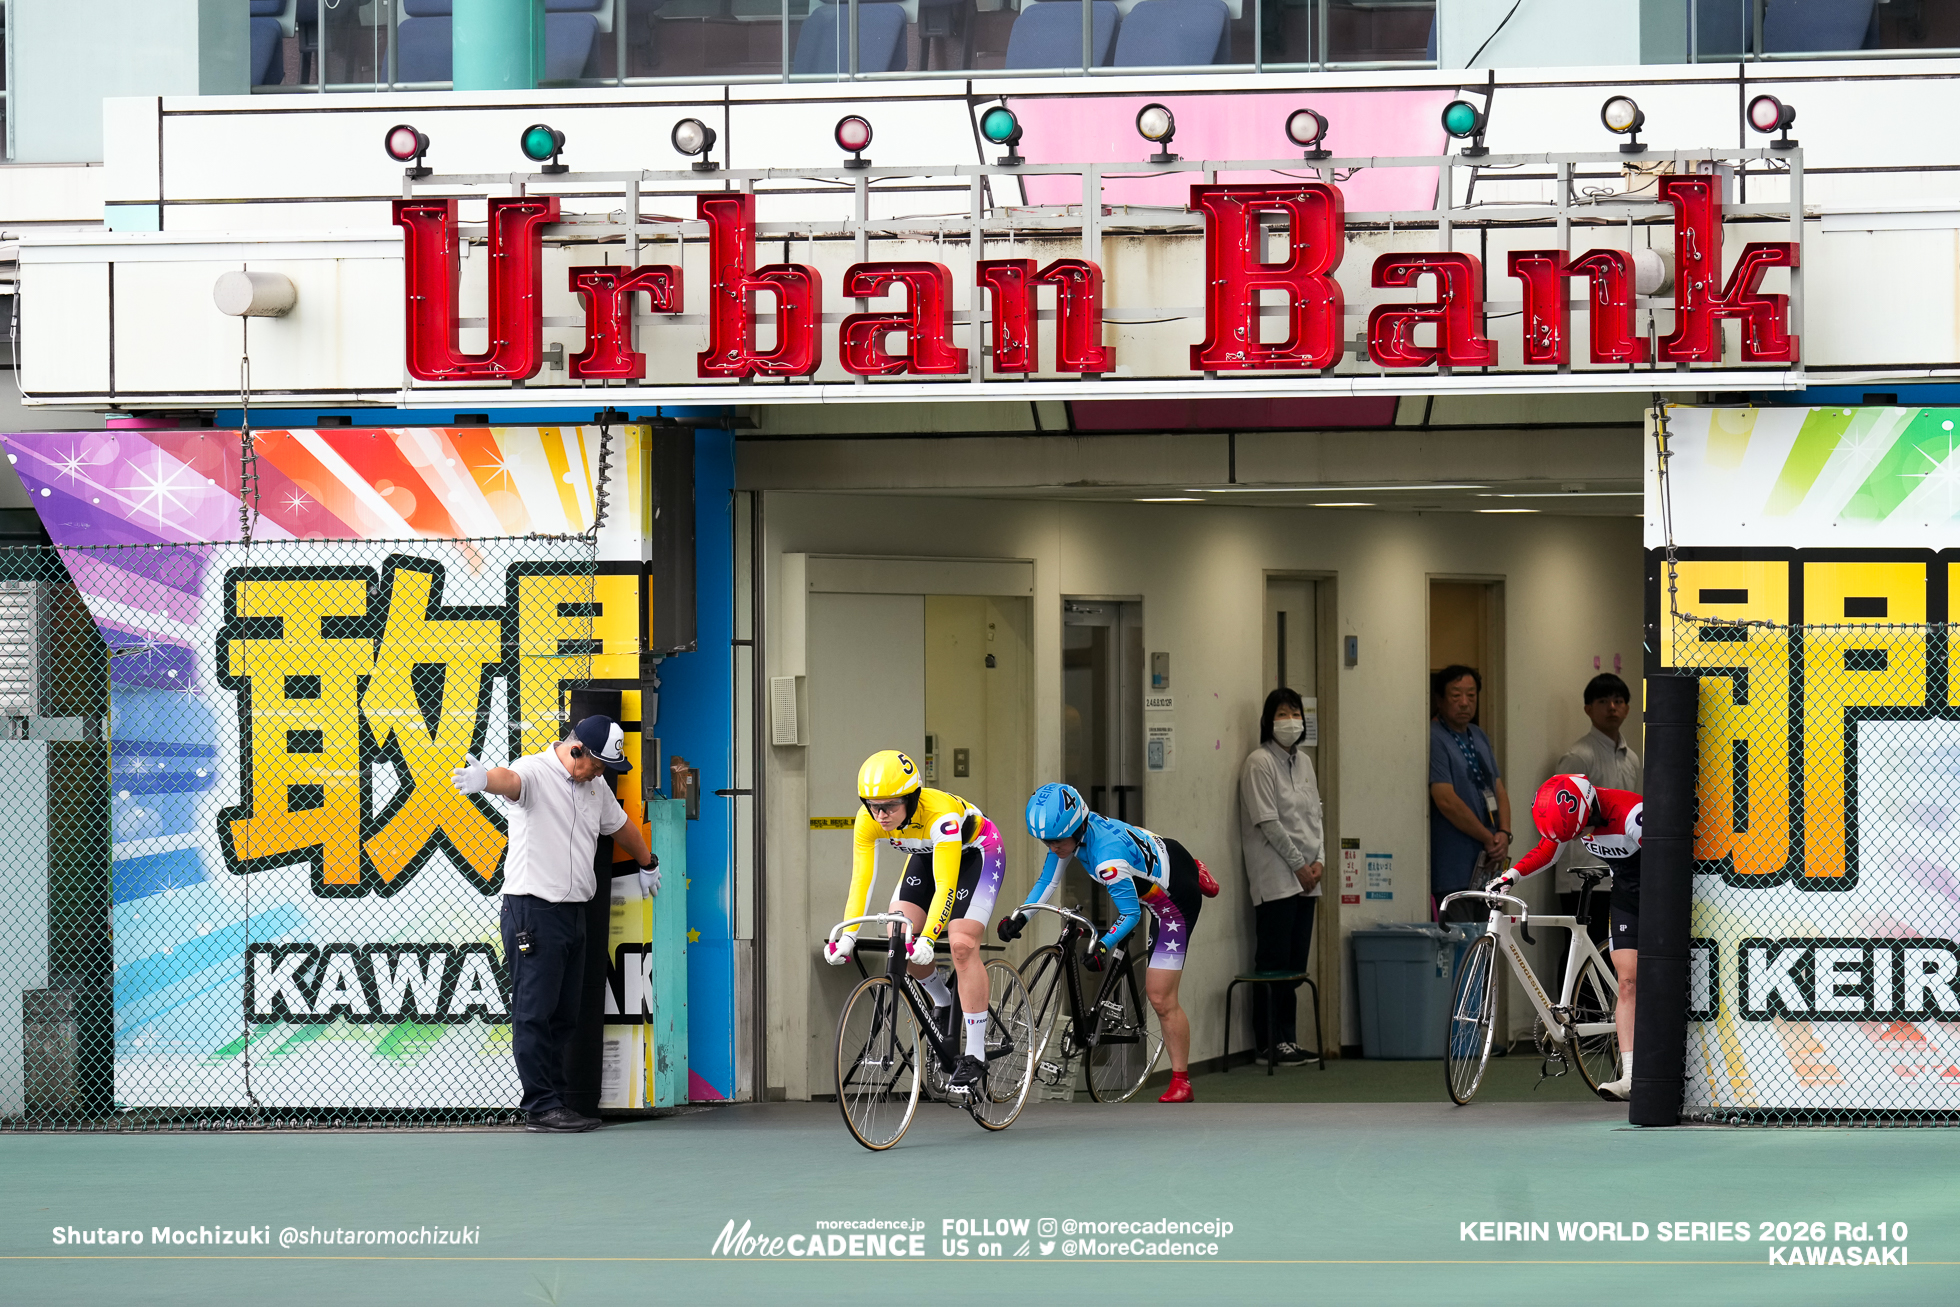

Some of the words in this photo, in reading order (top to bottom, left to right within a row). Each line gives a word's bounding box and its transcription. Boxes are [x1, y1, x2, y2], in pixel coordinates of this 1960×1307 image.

[393, 193, 1115, 385] Urban
[1190, 175, 1801, 372] Bank
[897, 753, 914, 776] 5
[1062, 788, 1076, 811] 4
[1538, 778, 1559, 818] KEIRIN
[1556, 789, 1578, 814] 3
[1126, 829, 1159, 877] 4
[939, 888, 954, 924] KEIRIN
[1748, 948, 1960, 1012] KEIR
[904, 973, 944, 1043] BRIDGESTONE
